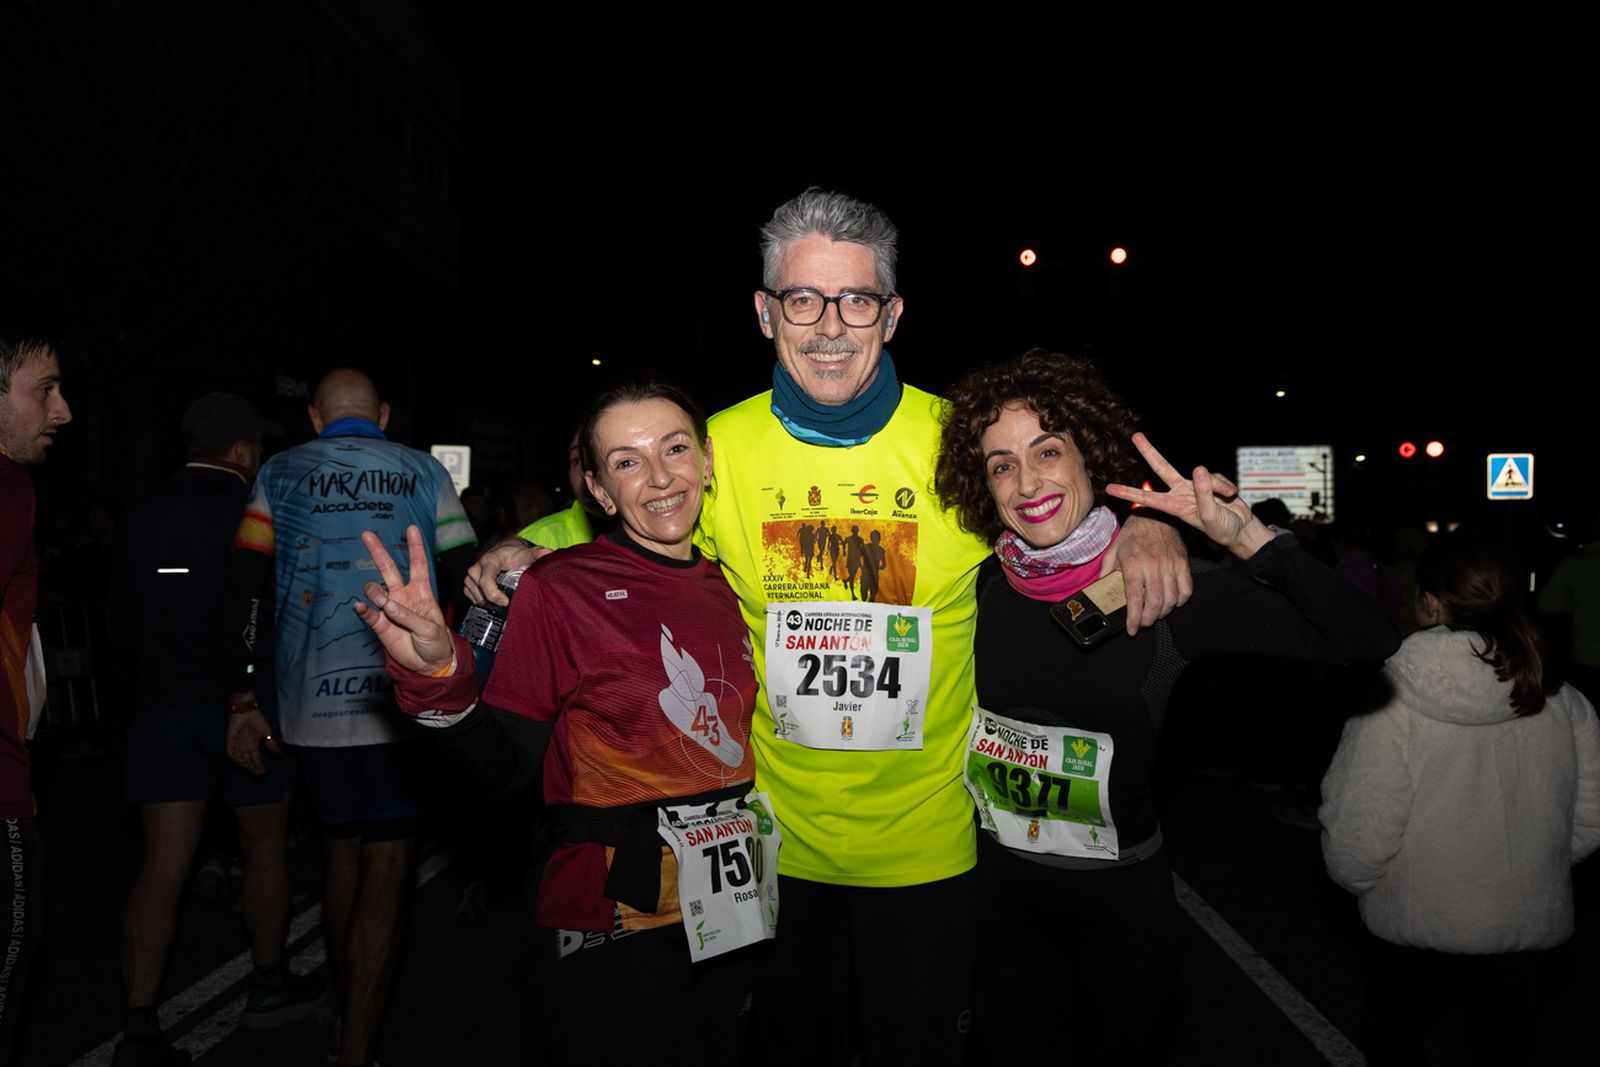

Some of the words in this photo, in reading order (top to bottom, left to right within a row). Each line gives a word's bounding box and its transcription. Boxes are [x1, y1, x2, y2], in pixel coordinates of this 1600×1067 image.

[308, 470, 417, 500] MARATHON
[310, 500, 394, 515] Alcaudete
[764, 583, 798, 591] CARRERA
[798, 582, 830, 590] URBANA
[787, 614, 802, 626] 43
[804, 617, 851, 631] NOCHE
[854, 618, 872, 632] DE
[785, 635, 817, 650] SAN
[315, 674, 386, 697] ALCAL
[796, 653, 902, 698] 2534
[832, 701, 862, 712] Javier
[690, 705, 720, 747] 43
[997, 726, 1027, 749] NOCHE
[1031, 738, 1049, 750] DE
[976, 738, 1006, 759] SAN
[1005, 750, 1049, 769] ANTÓN
[987, 761, 1072, 815] 9377
[685, 826, 713, 847] SAN
[717, 819, 753, 839] ANTÓN
[734, 888, 760, 903] Rosa
